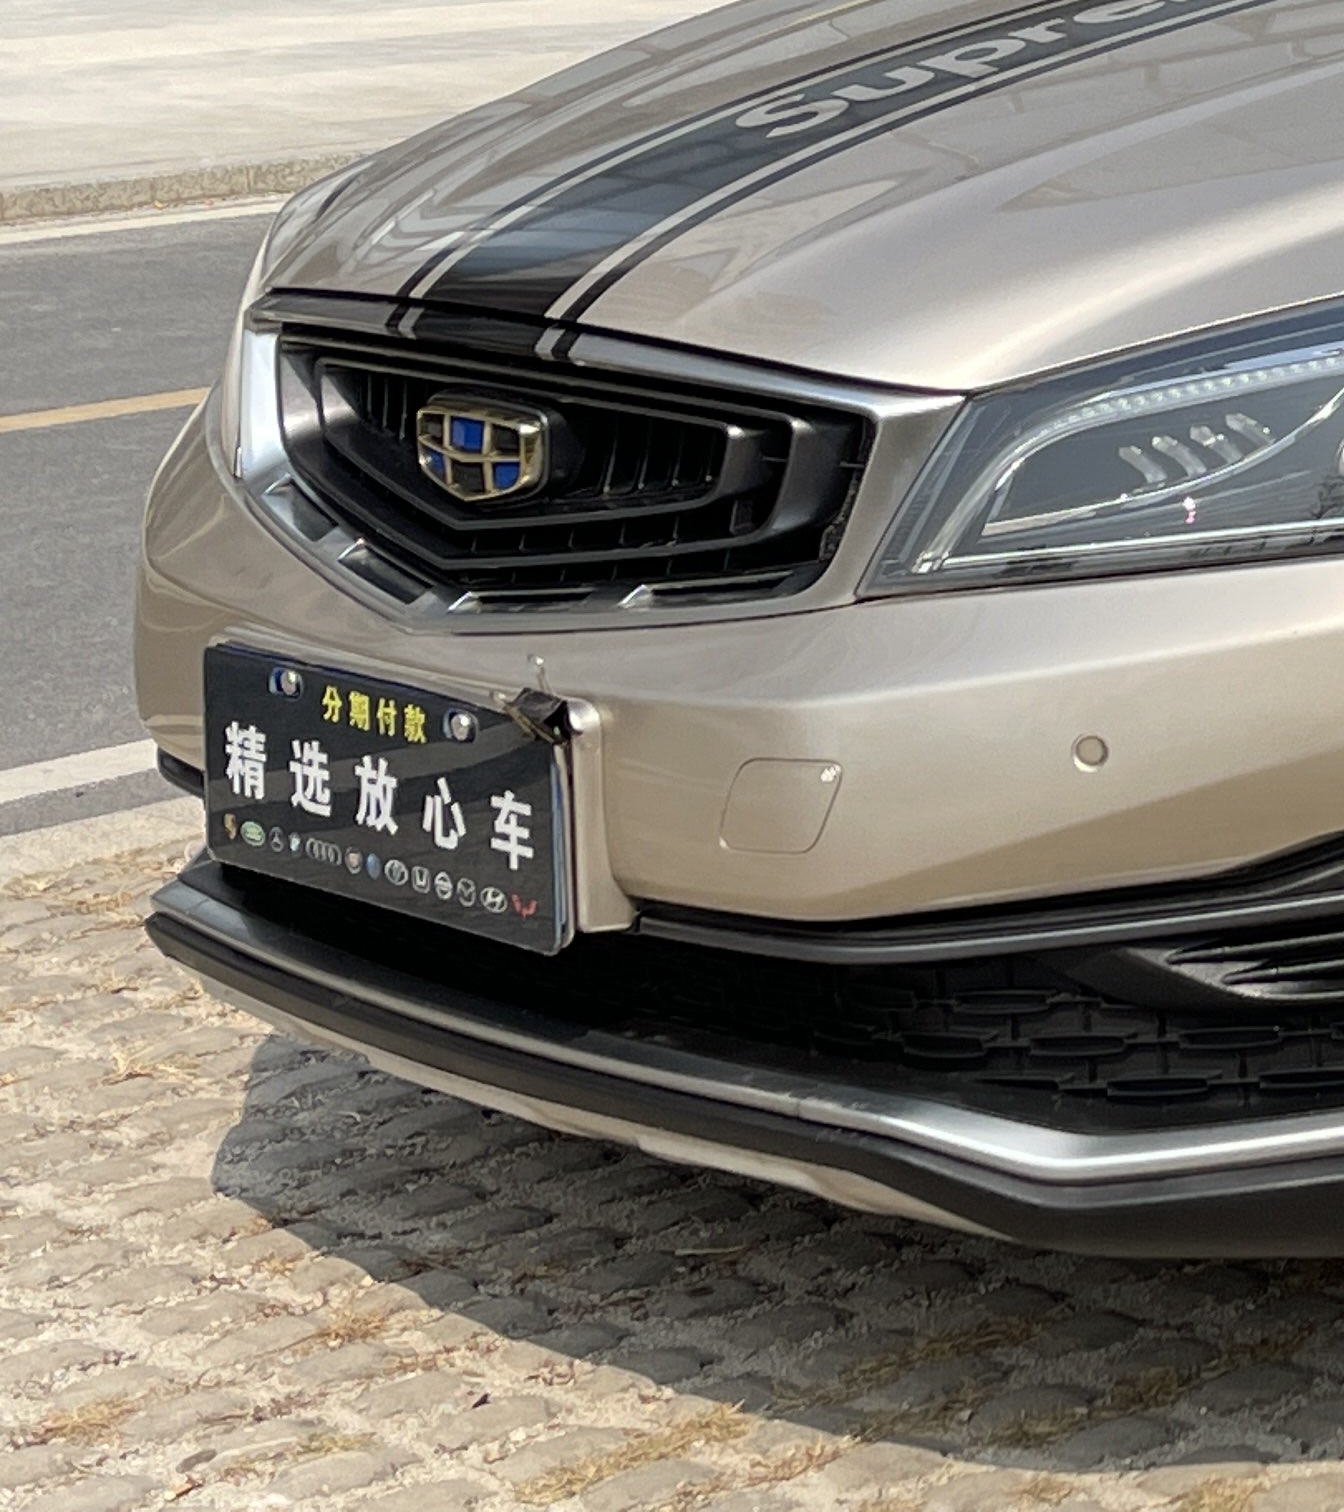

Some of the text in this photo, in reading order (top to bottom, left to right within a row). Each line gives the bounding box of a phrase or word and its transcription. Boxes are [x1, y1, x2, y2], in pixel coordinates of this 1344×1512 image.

[321, 685, 428, 744] 分期付款
[223, 720, 535, 871] 精选放心车
